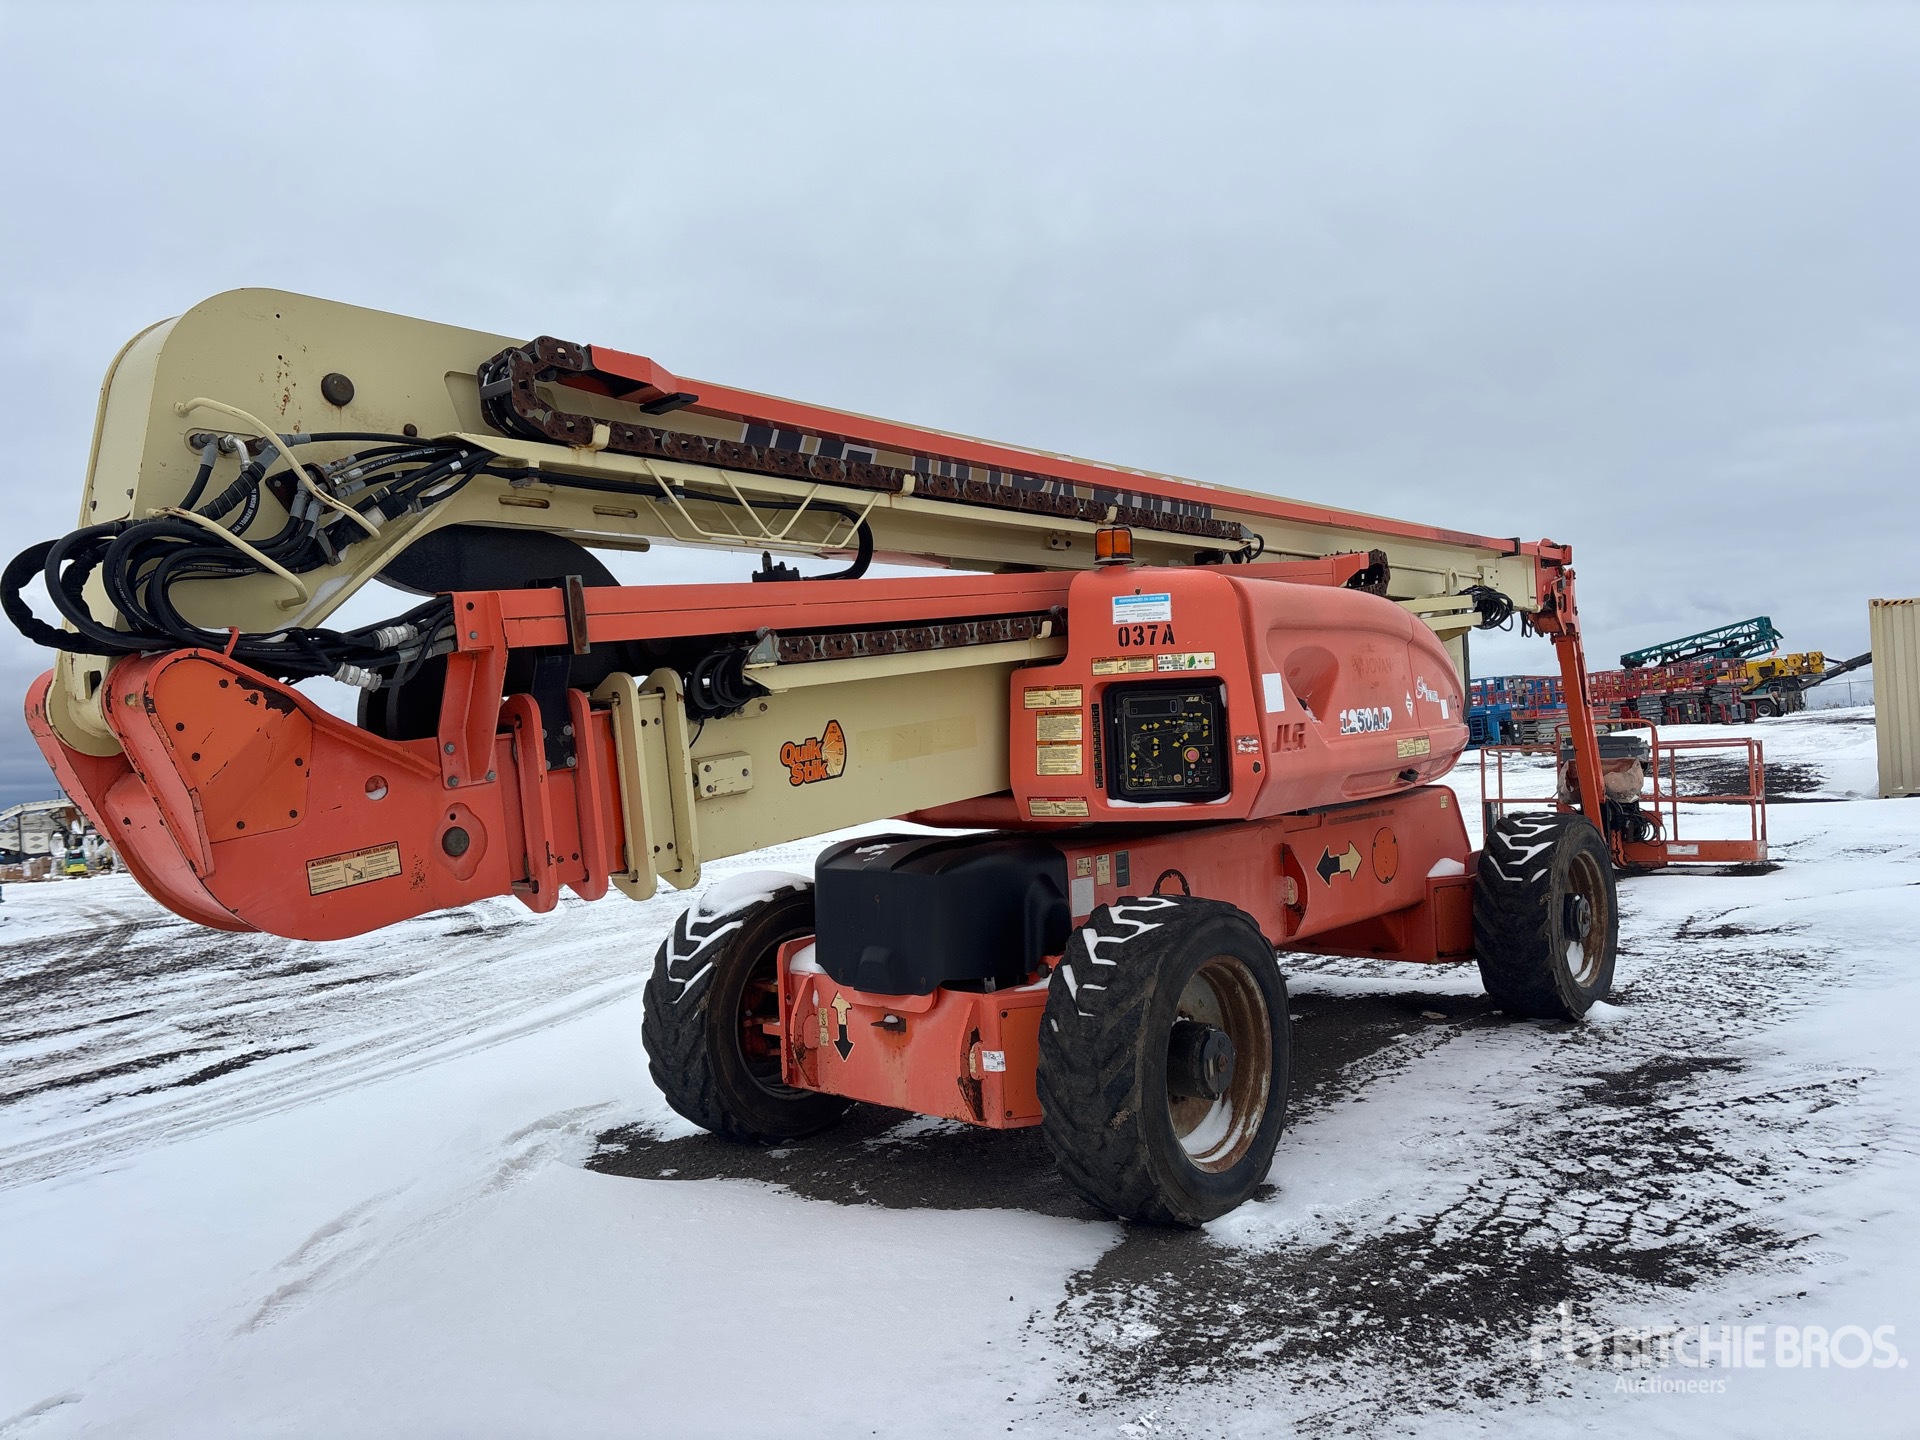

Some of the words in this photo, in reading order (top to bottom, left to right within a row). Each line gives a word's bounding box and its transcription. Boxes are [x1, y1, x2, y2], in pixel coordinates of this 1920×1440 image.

[1118, 624, 1175, 647] 037A
[1339, 706, 1392, 736] 1250AJP
[1271, 722, 1306, 754] JLG
[781, 738, 823, 766] Quik
[791, 759, 829, 786] Stik
[316, 856, 342, 866] WARNING
